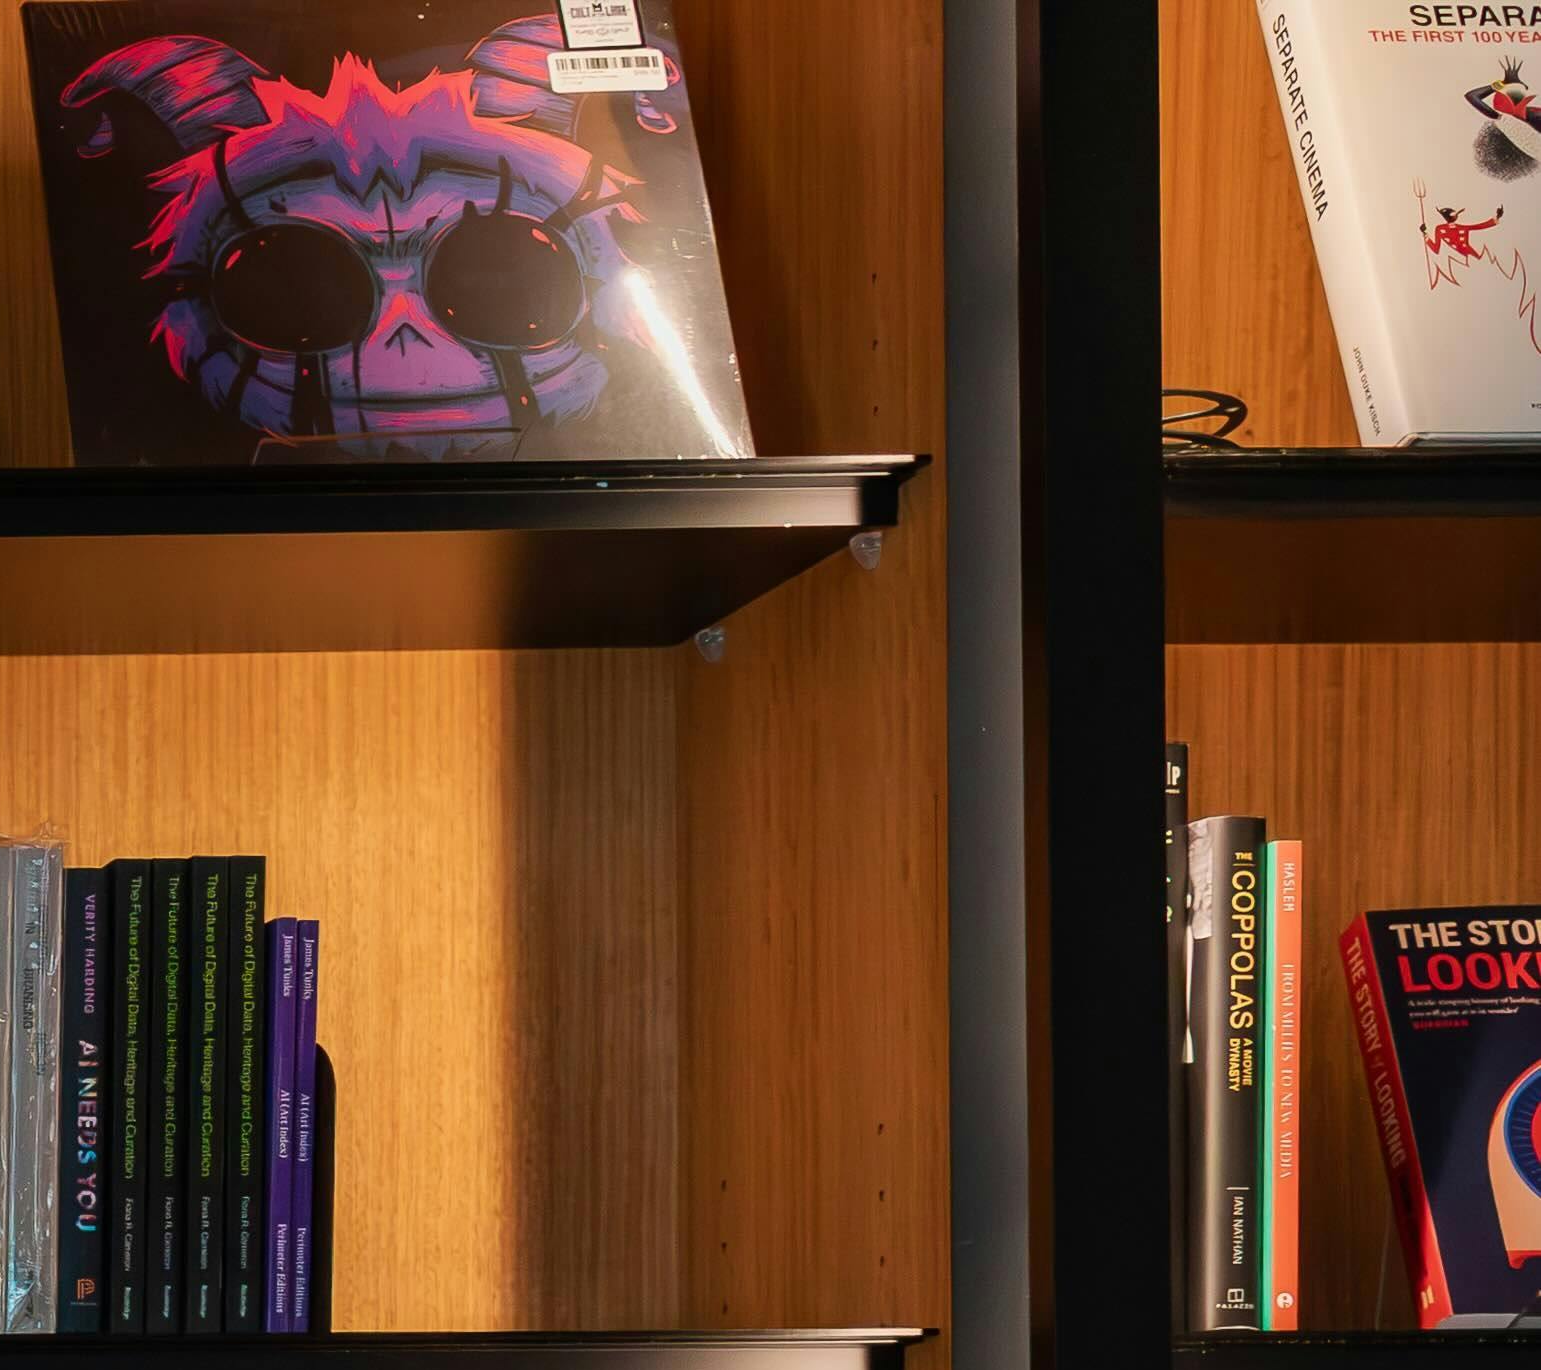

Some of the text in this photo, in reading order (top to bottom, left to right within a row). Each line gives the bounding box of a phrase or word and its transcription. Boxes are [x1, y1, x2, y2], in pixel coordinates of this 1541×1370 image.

[1368, 30, 1501, 43] THE FIRST 100
[1272, 14, 1329, 222] SEPARATE CINEMA
[1235, 852, 1253, 860] THE
[1230, 871, 1255, 1030] COPPOLAS
[1229, 1038, 1240, 1092] DYNASTY
[1242, 1053, 1252, 1086] MOVIE
[1232, 1196, 1243, 1265] IAN NATHAN
